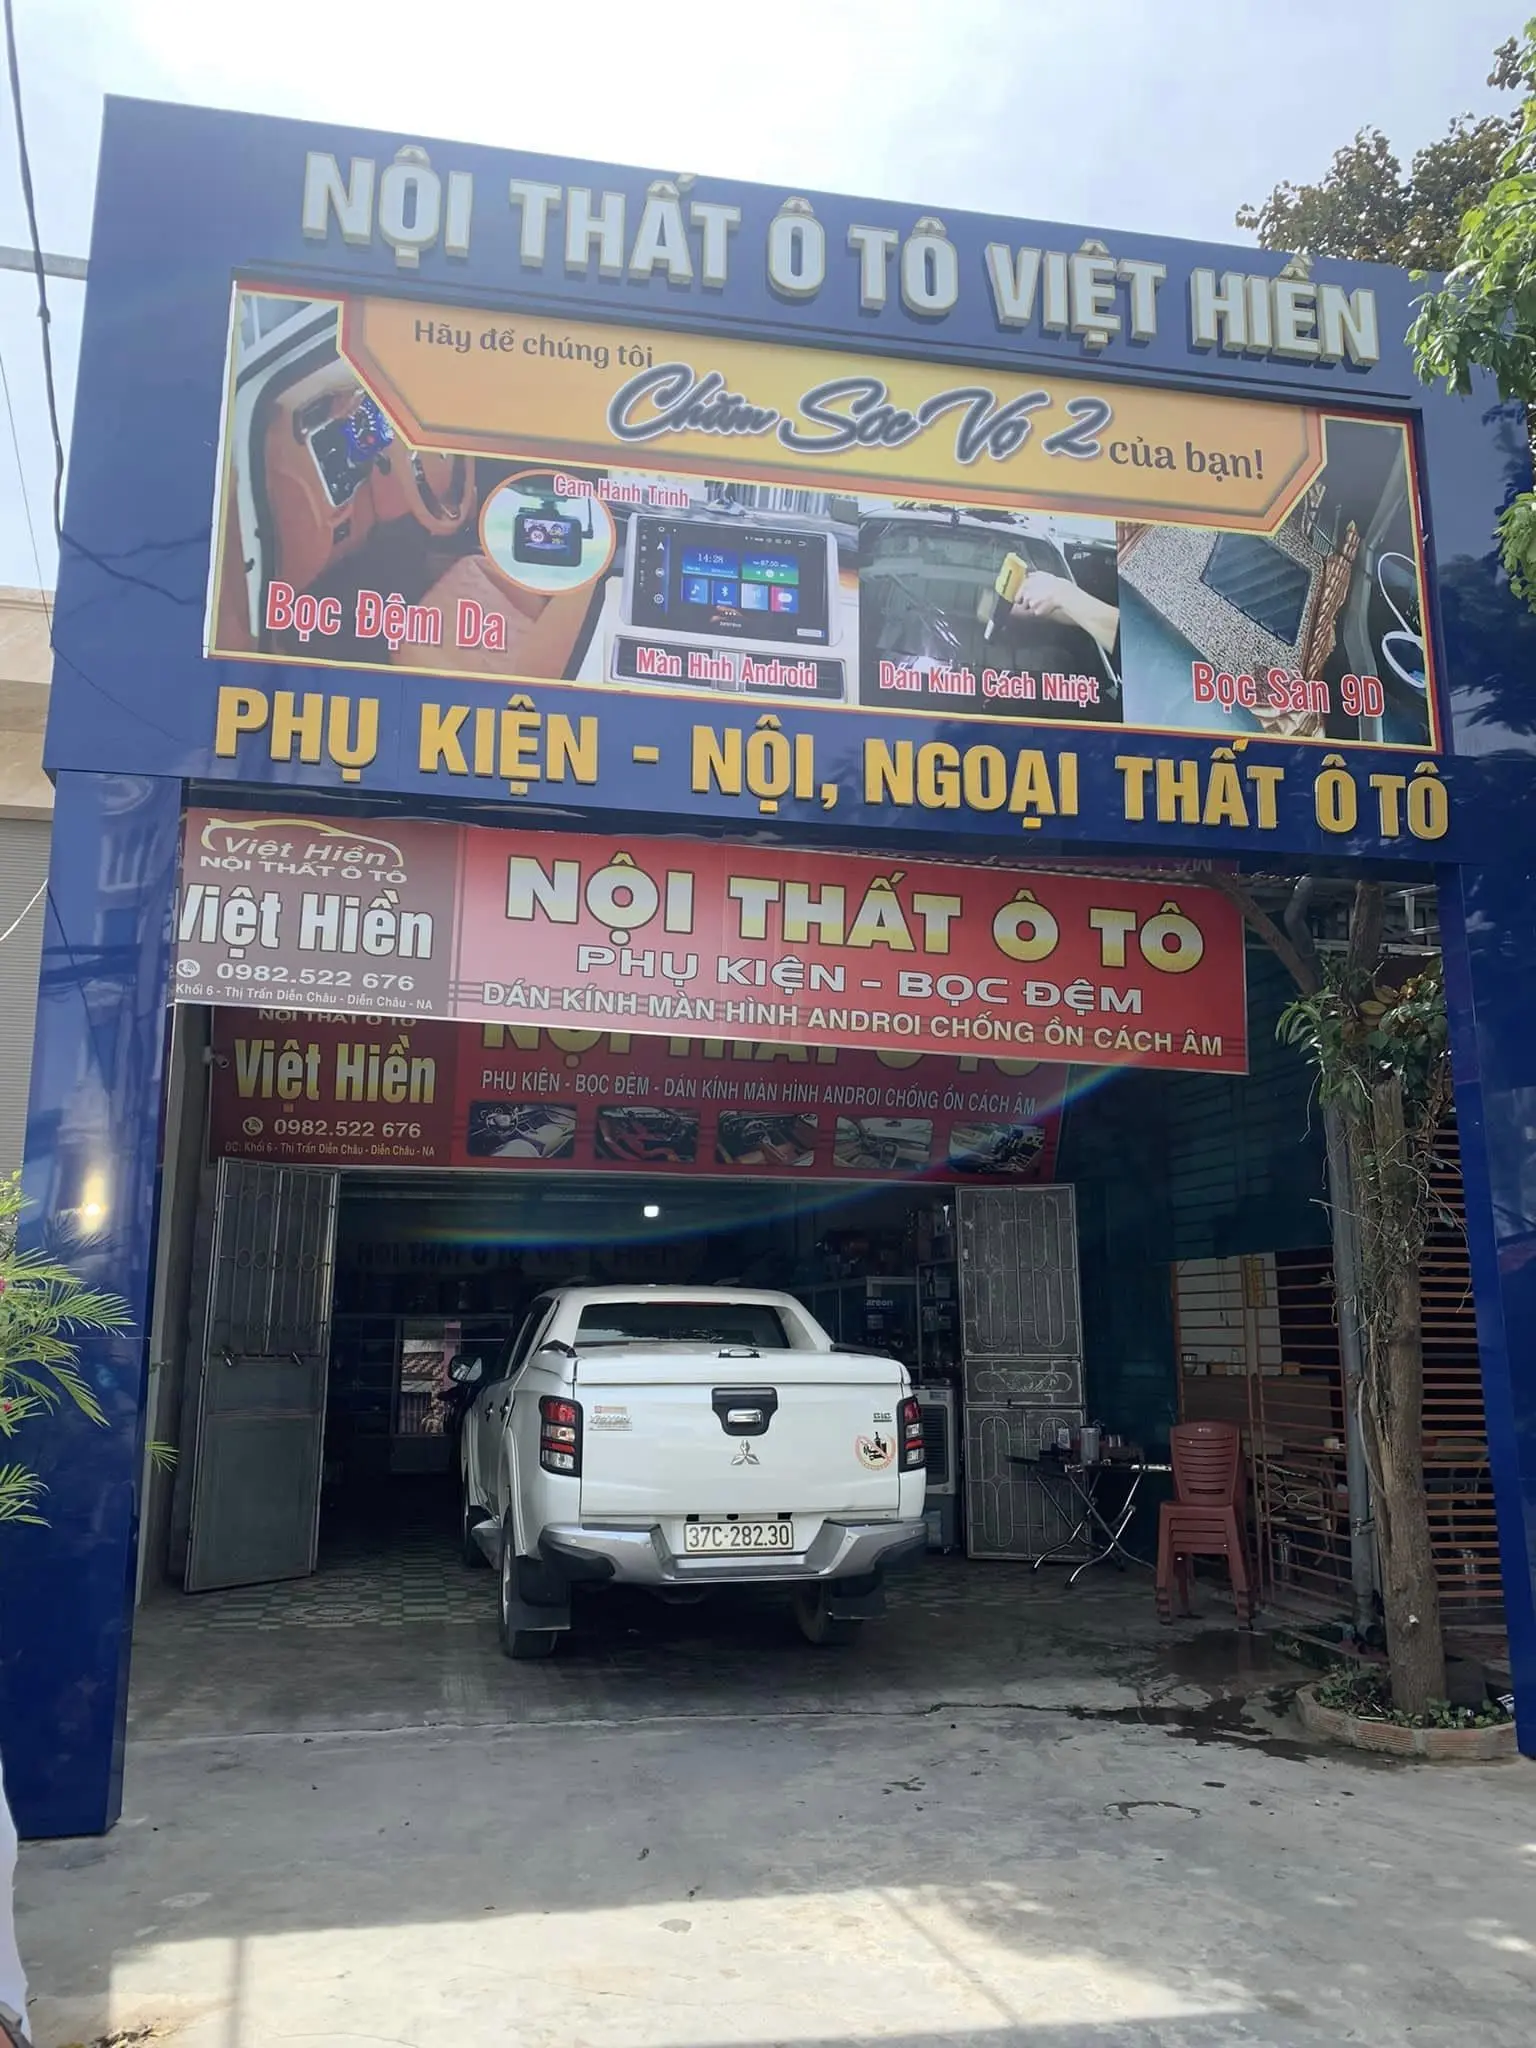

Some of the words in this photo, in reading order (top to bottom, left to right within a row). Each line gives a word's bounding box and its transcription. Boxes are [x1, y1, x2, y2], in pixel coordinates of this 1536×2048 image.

[303, 145, 473, 269] NỘI
[510, 172, 741, 288] THẤT
[768, 196, 826, 298] Ô
[848, 216, 959, 316] TÔ
[985, 238, 1167, 349] VIỆT
[1190, 253, 1380, 367] HIỀN
[414, 319, 472, 353] Hãy
[479, 328, 516, 353] để
[522, 332, 610, 369] chúng
[617, 344, 654, 368] tôi
[1041, 396, 1112, 458] 2
[1109, 436, 1177, 471] của
[1186, 441, 1265, 482] bạn!
[553, 474, 593, 498] Cam
[598, 478, 642, 504] Hành
[647, 483, 691, 510] Trình
[266, 581, 342, 641] Bọc
[355, 589, 442, 650] Đệm
[456, 598, 507, 650] Da
[636, 647, 682, 677] Màn
[688, 651, 734, 682] Hình
[740, 656, 818, 689] Android
[879, 660, 922, 692] Dán
[928, 664, 976, 696] Kính
[981, 669, 1036, 700] Cách
[1041, 673, 1100, 708] Nhiệt
[1191, 661, 1257, 714] Bọc
[1266, 667, 1331, 715] Sàn
[1340, 673, 1385, 718] 9D
[216, 686, 380, 783] PHỤ
[418, 693, 599, 796] KIỆN
[632, 745, 660, 764] -
[691, 714, 839, 815] NỘI,
[863, 738, 1080, 829] NGOẠI
[1114, 738, 1285, 830] THẤT
[1314, 753, 1358, 834] Ô
[1369, 761, 1449, 840] TÔ
[200, 855, 252, 873] NỘI
[258, 860, 336, 878] THẤT
[341, 865, 363, 880] Ô
[368, 869, 409, 885] TÔ
[225, 836, 295, 860] Việt
[304, 843, 387, 866] Hiền
[297, 887, 435, 960] Hiền
[505, 850, 695, 946] NỘI
[728, 872, 963, 956] THẤT
[991, 887, 1060, 963] Ô
[1087, 900, 1205, 974] TÔ
[206, 985, 214, 996] 6
[225, 986, 244, 1001] Thị
[306, 991, 337, 1004] Châu
[376, 995, 408, 1009] Châu
[416, 1000, 434, 1011] NA
[216, 961, 353, 988] 0982.522
[362, 972, 415, 991] 676
[576, 943, 699, 988] PHỤ
[715, 953, 847, 995] KIỆN
[861, 978, 883, 989] -
[897, 969, 1010, 1007] BỌC
[1022, 977, 1143, 1017] ĐỆM
[482, 978, 551, 1010] DÁN
[560, 983, 639, 1017] KÍNH
[647, 990, 716, 1022] MÀN
[725, 996, 799, 1028] HÌNH
[806, 1005, 921, 1036] ANDROI
[929, 1010, 1035, 1044] CHỐNG
[1092, 1023, 1173, 1054] CÁCH
[1180, 1027, 1225, 1058] ÂM
[234, 1038, 322, 1113] Việt
[335, 1034, 436, 1104] Hiền
[482, 1070, 517, 1095] PHỤ
[521, 1066, 560, 1095] KIỆN
[575, 1073, 609, 1097] BỌC
[614, 1071, 649, 1098] ĐỆM
[664, 1073, 697, 1098] DÁN
[701, 1075, 738, 1100] KÍNH
[743, 1077, 778, 1101] MÀN
[782, 1078, 819, 1103] HÌNH
[823, 1085, 882, 1106] ANDROI
[885, 1081, 940, 1109] CHỐNG
[968, 1088, 1010, 1113] CÁCH
[1013, 1091, 1037, 1116] ÂM
[274, 1118, 375, 1138] 0982.522
[382, 1121, 422, 1139] 676
[422, 1146, 435, 1156] NA
